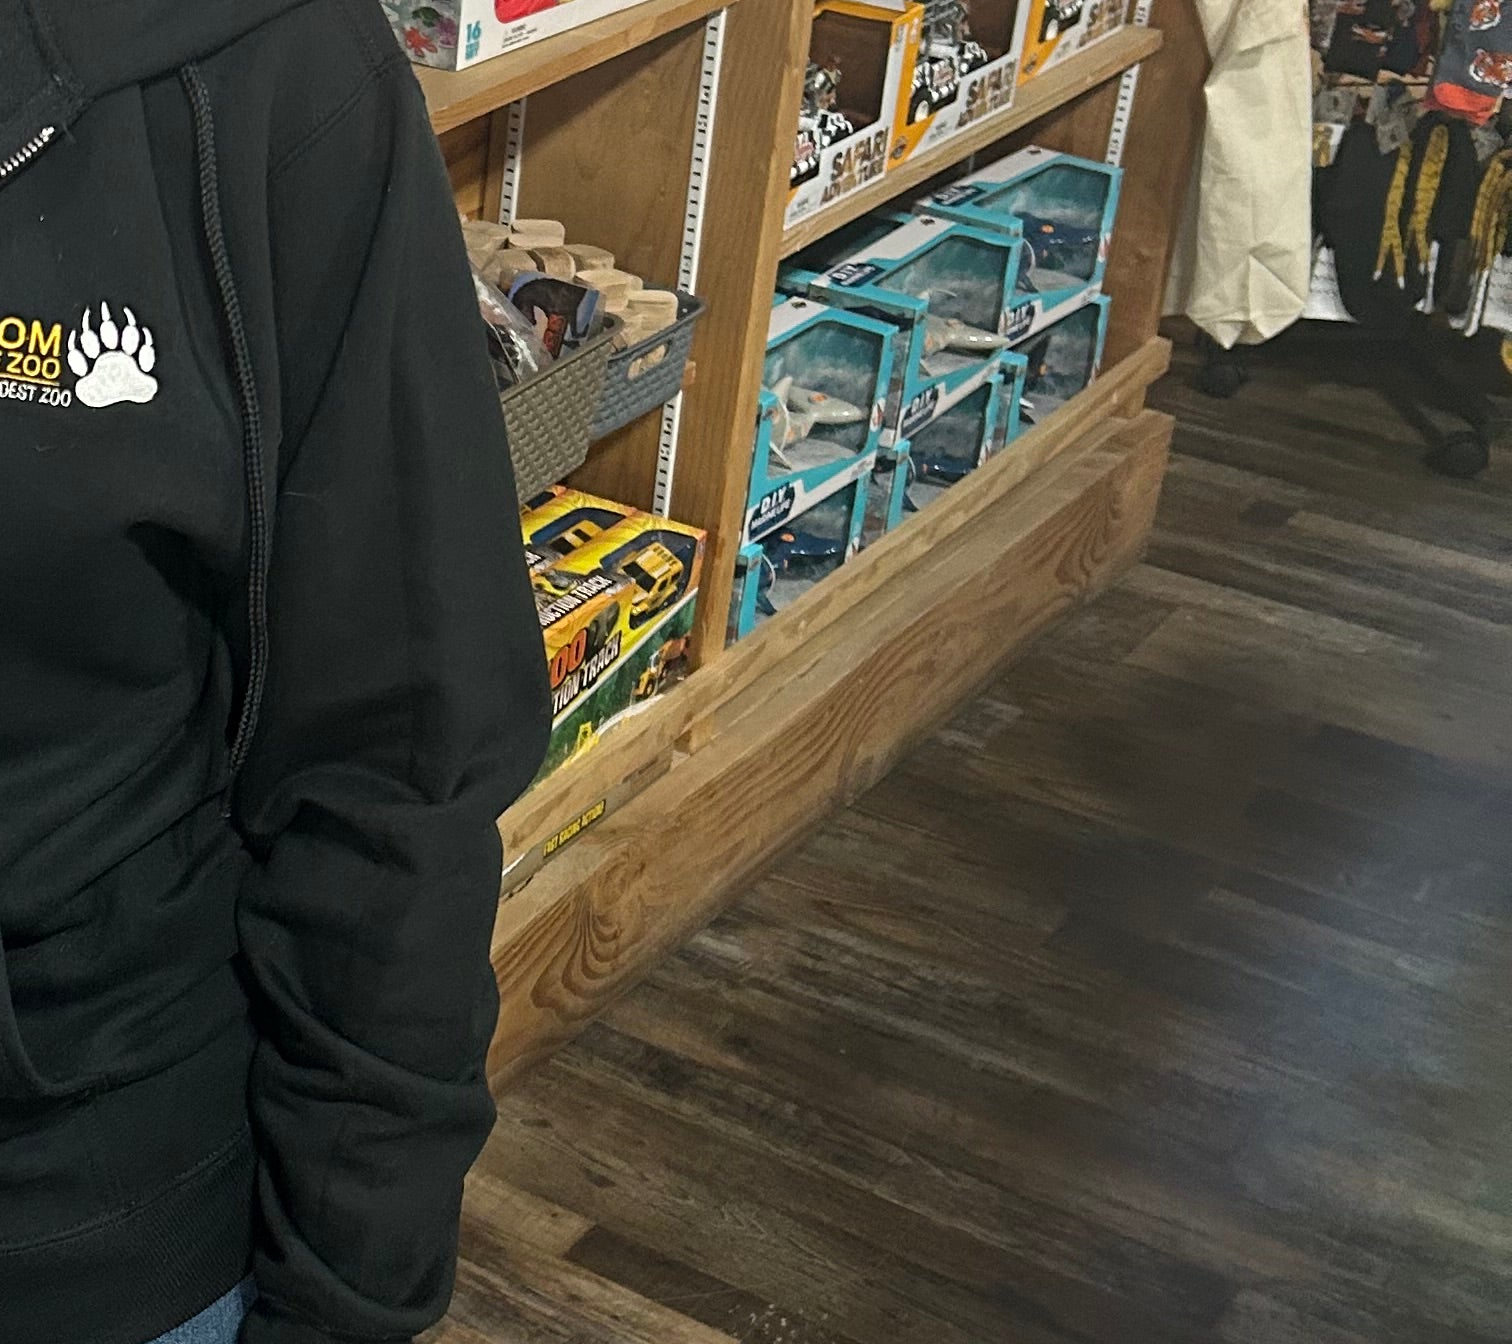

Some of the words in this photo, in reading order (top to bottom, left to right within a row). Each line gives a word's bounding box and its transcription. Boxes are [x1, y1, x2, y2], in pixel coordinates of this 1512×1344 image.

[466, 21, 482, 43] 16
[7, 356, 61, 380] ZOO
[38, 387, 72, 408] ZOO
[553, 675, 580, 715] TION
